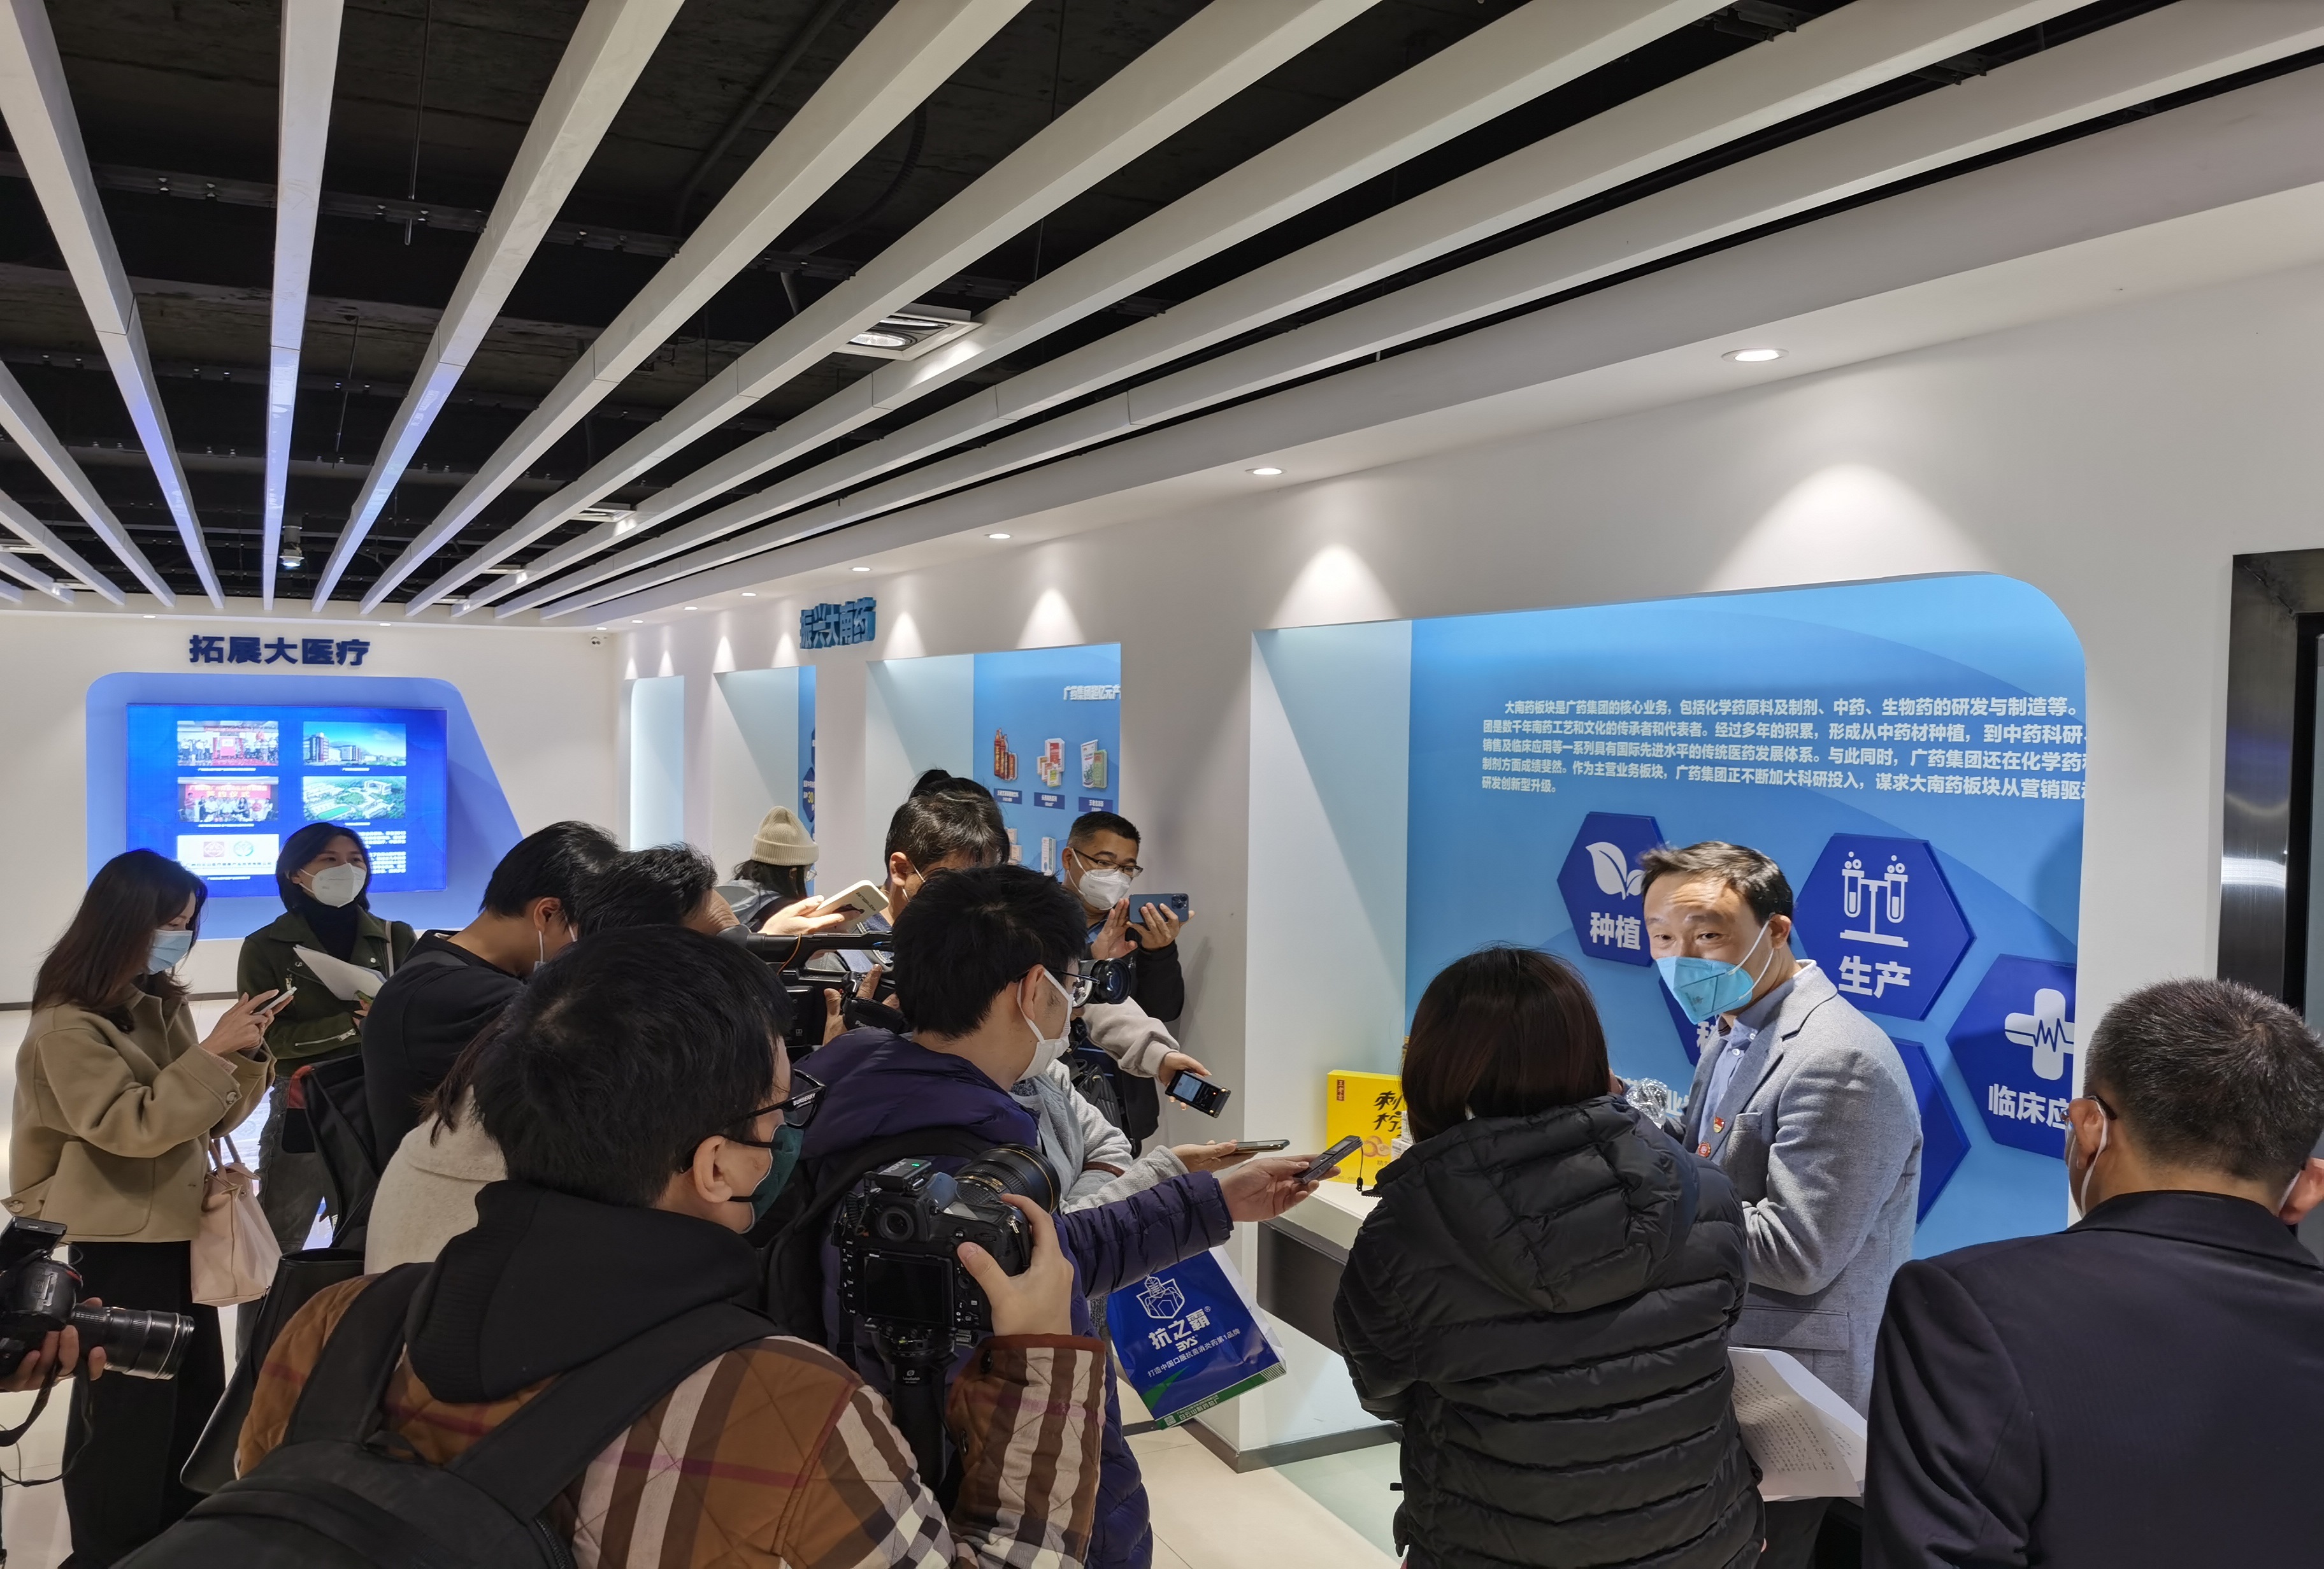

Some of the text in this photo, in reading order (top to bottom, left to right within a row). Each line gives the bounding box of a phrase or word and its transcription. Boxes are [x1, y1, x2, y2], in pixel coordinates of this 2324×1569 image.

[800, 597, 877, 649] 振兴大南药
[189, 634, 371, 666] 拓展大医疗
[1482, 776, 1556, 793] 研发创新型升级。
[1589, 911, 1642, 950] 种植
[1838, 955, 1911, 998] 生产
